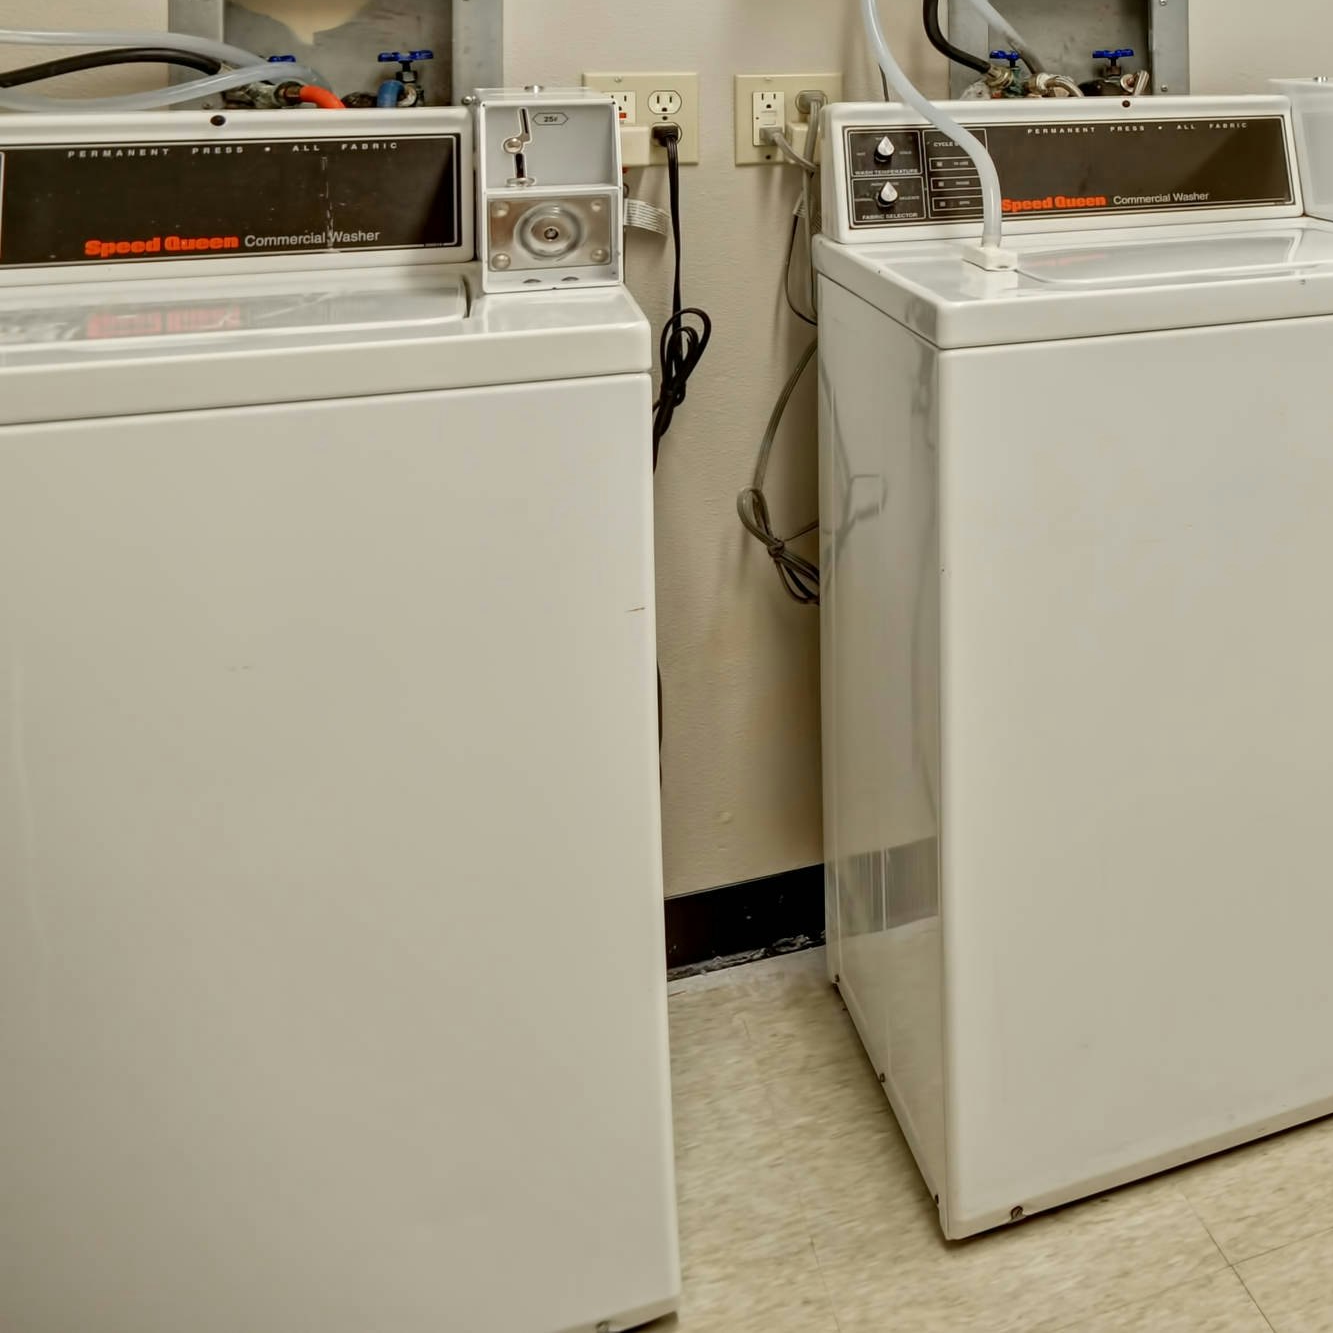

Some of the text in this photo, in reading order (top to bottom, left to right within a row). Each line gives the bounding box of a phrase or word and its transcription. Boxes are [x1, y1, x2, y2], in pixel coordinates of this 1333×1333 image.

[68, 148, 169, 158] PERMANENT
[192, 146, 243, 155] PRESS
[341, 142, 397, 151] FABRIC
[1002, 192, 1209, 213] Speed Queen Commercial Washer
[84, 230, 380, 257] Speed Queen Commercial Washer
